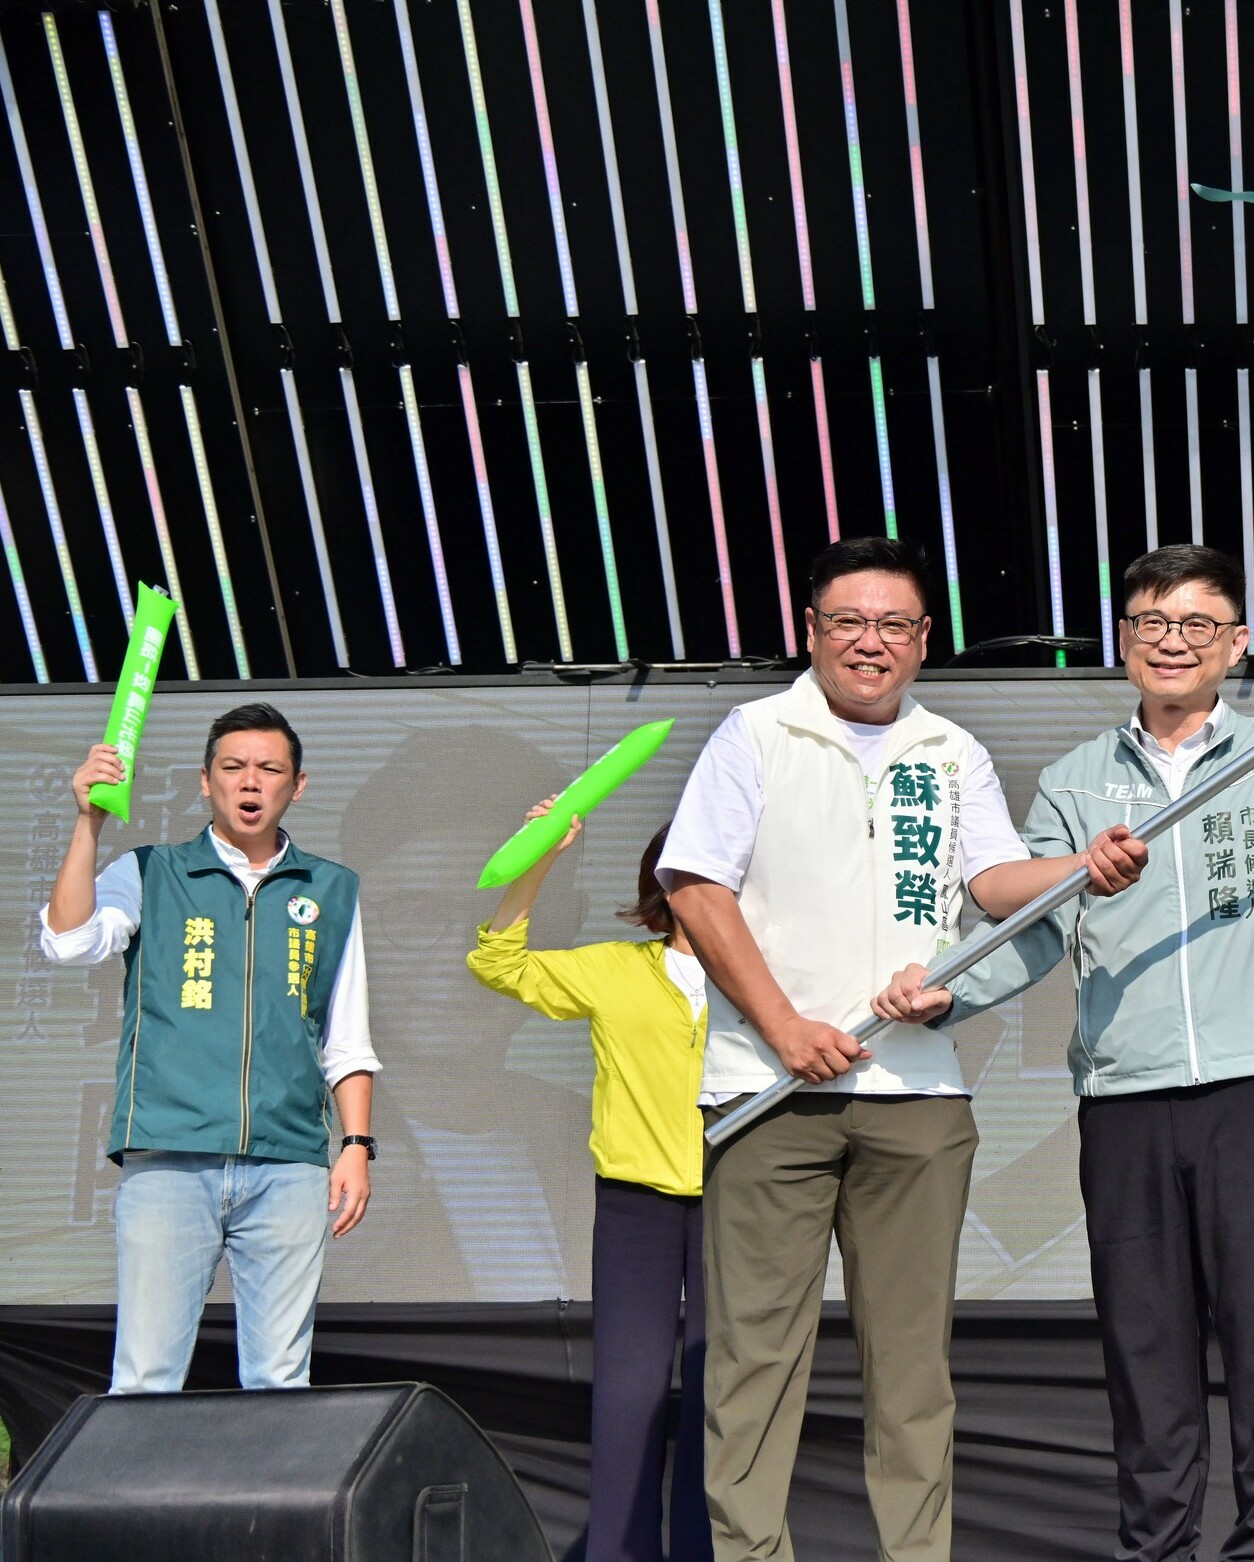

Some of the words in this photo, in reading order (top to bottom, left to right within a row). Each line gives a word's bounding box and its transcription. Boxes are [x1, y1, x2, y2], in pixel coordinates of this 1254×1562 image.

[1105, 782, 1153, 799] TEAM
[889, 762, 943, 927] 蘇致榮
[1202, 811, 1241, 921] 賴瑞隆
[181, 917, 215, 1010] 洪村銘
